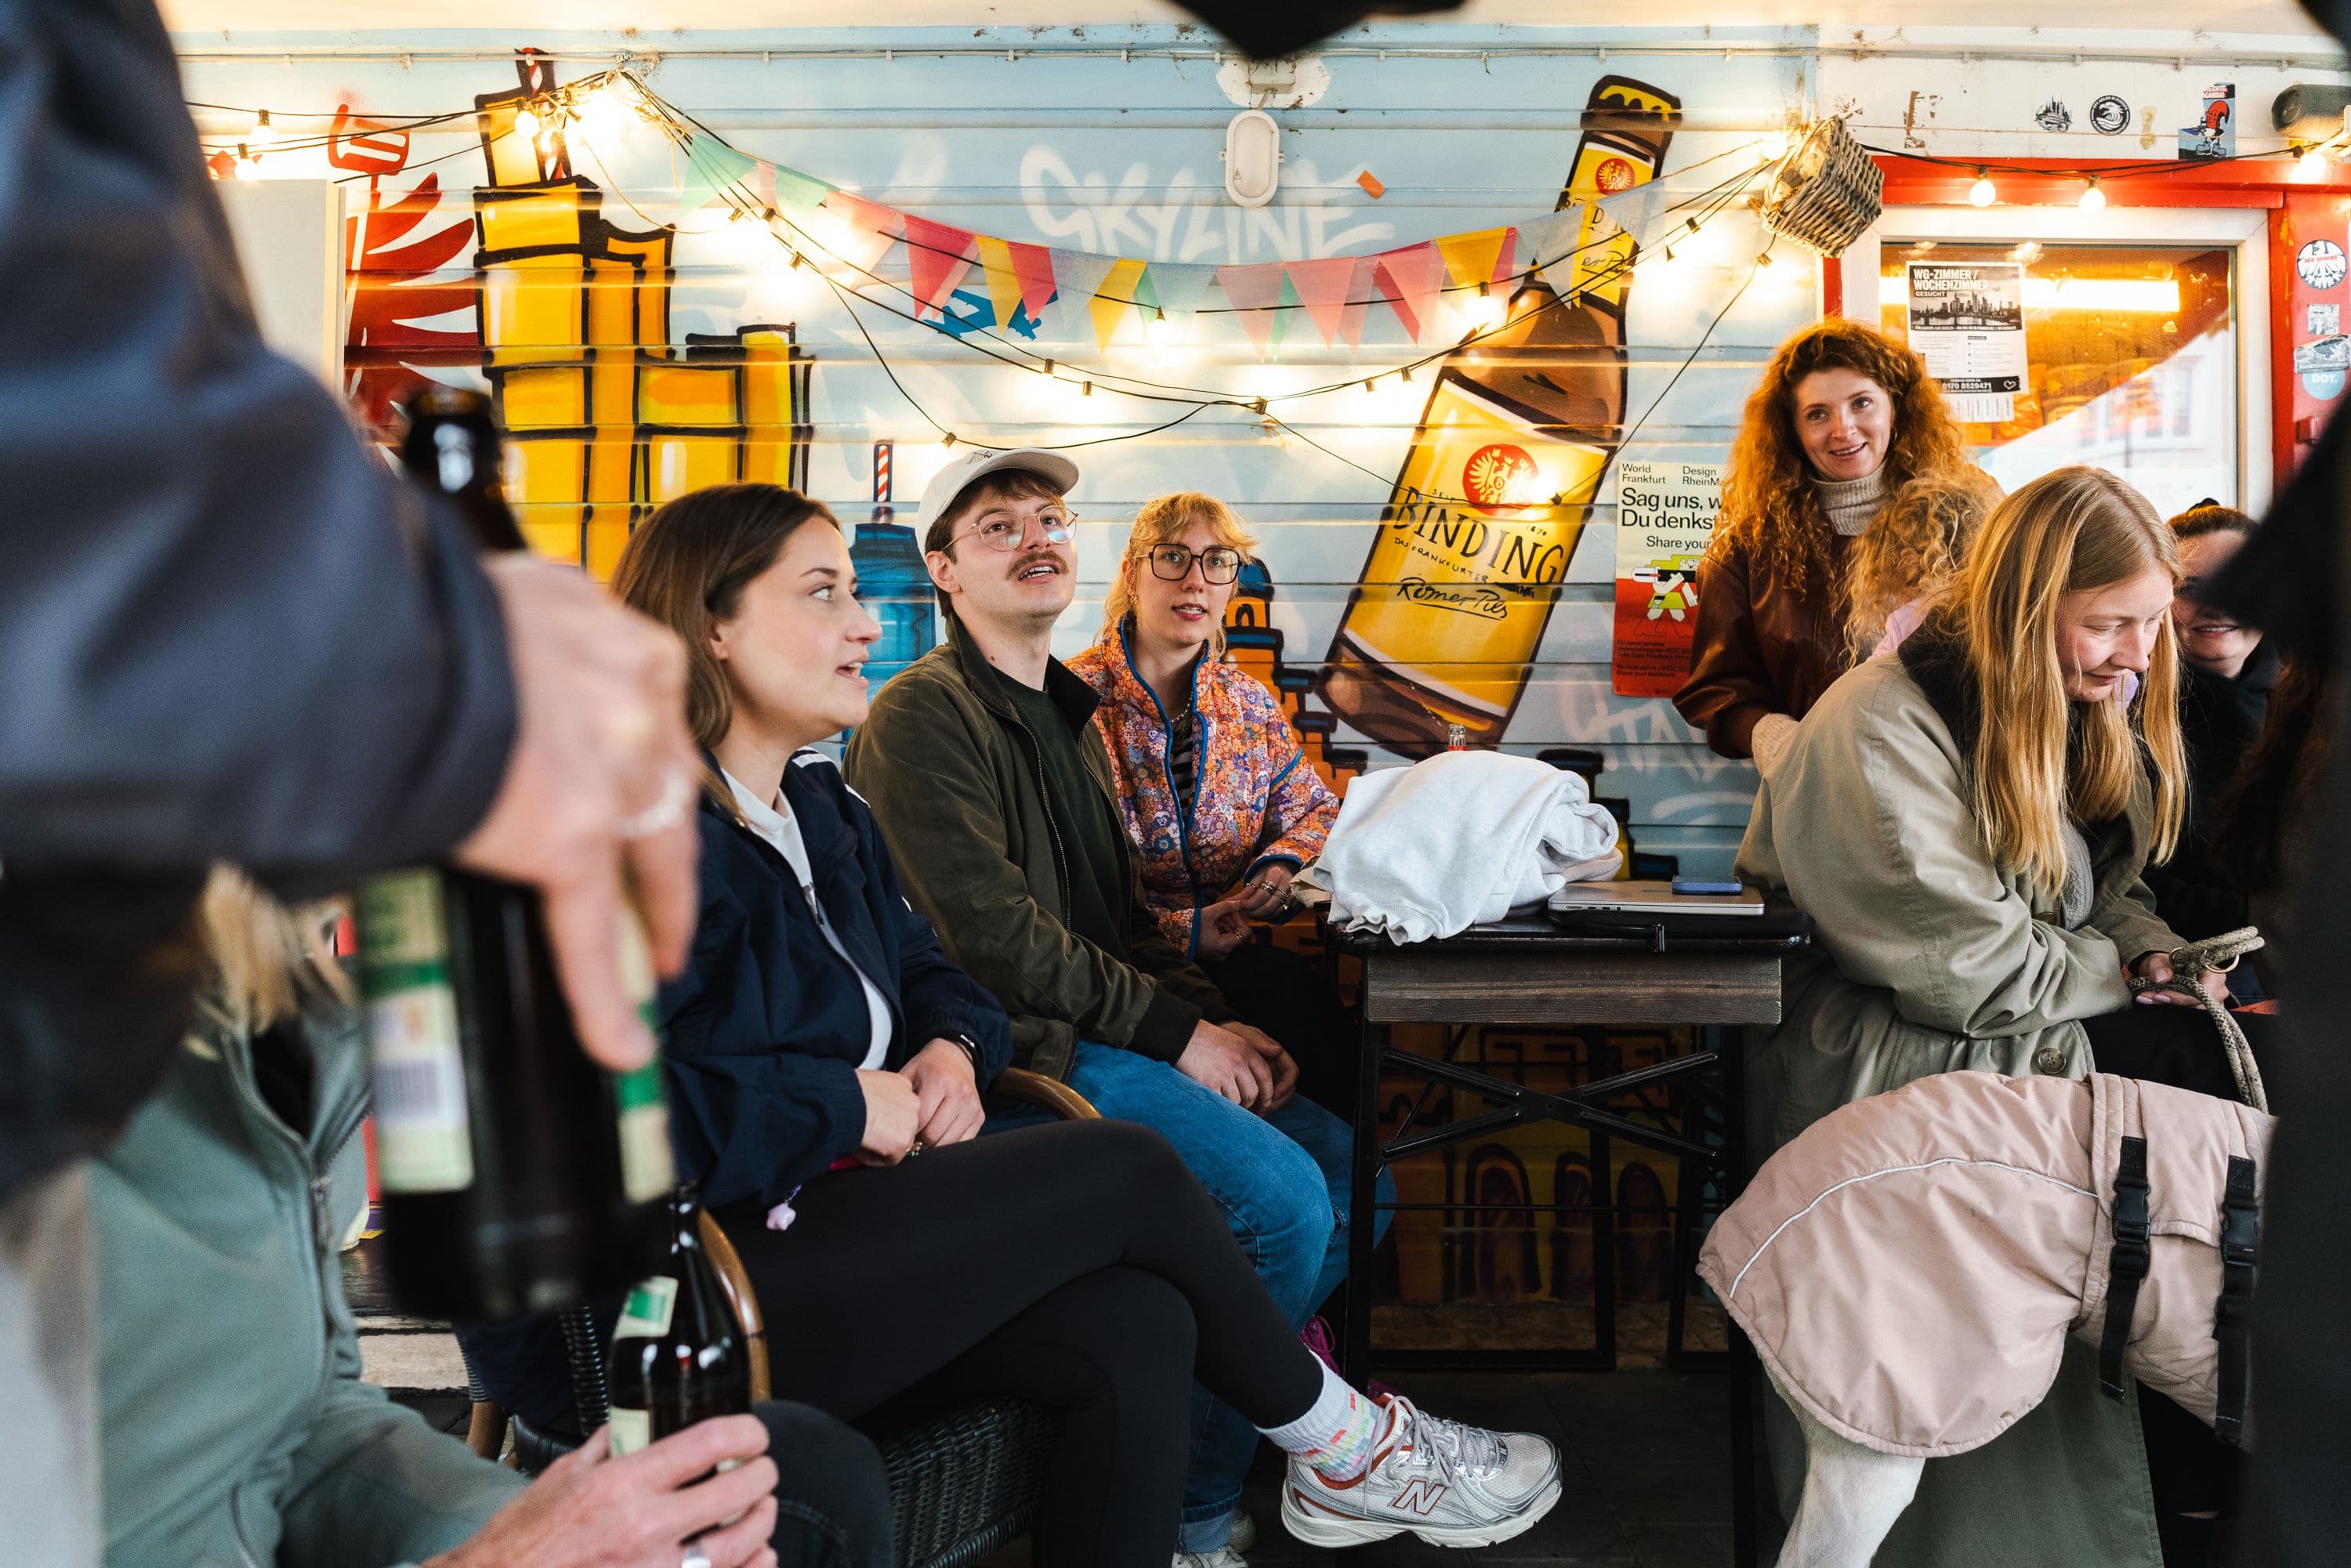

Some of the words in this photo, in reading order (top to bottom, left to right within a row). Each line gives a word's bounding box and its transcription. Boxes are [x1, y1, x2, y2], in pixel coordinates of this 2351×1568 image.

[1913, 269, 1972, 280] WG-ZIMMER
[1913, 279, 1989, 291] WOCHENZIMMER
[1622, 463, 1651, 473] World
[1683, 466, 1716, 477] Design
[1622, 474, 1666, 484] Frankfurt
[1683, 476, 1721, 486] RheinM
[1621, 487, 1660, 512] Sag
[1665, 495, 1703, 511] uns,
[1621, 509, 1650, 527] Du
[1393, 486, 1564, 585] BINDING
[1646, 535, 1683, 548] Share
[1684, 541, 1712, 551] your
[1411, 546, 1488, 584] FRANKFURTER
[1393, 1479, 1447, 1515] N
